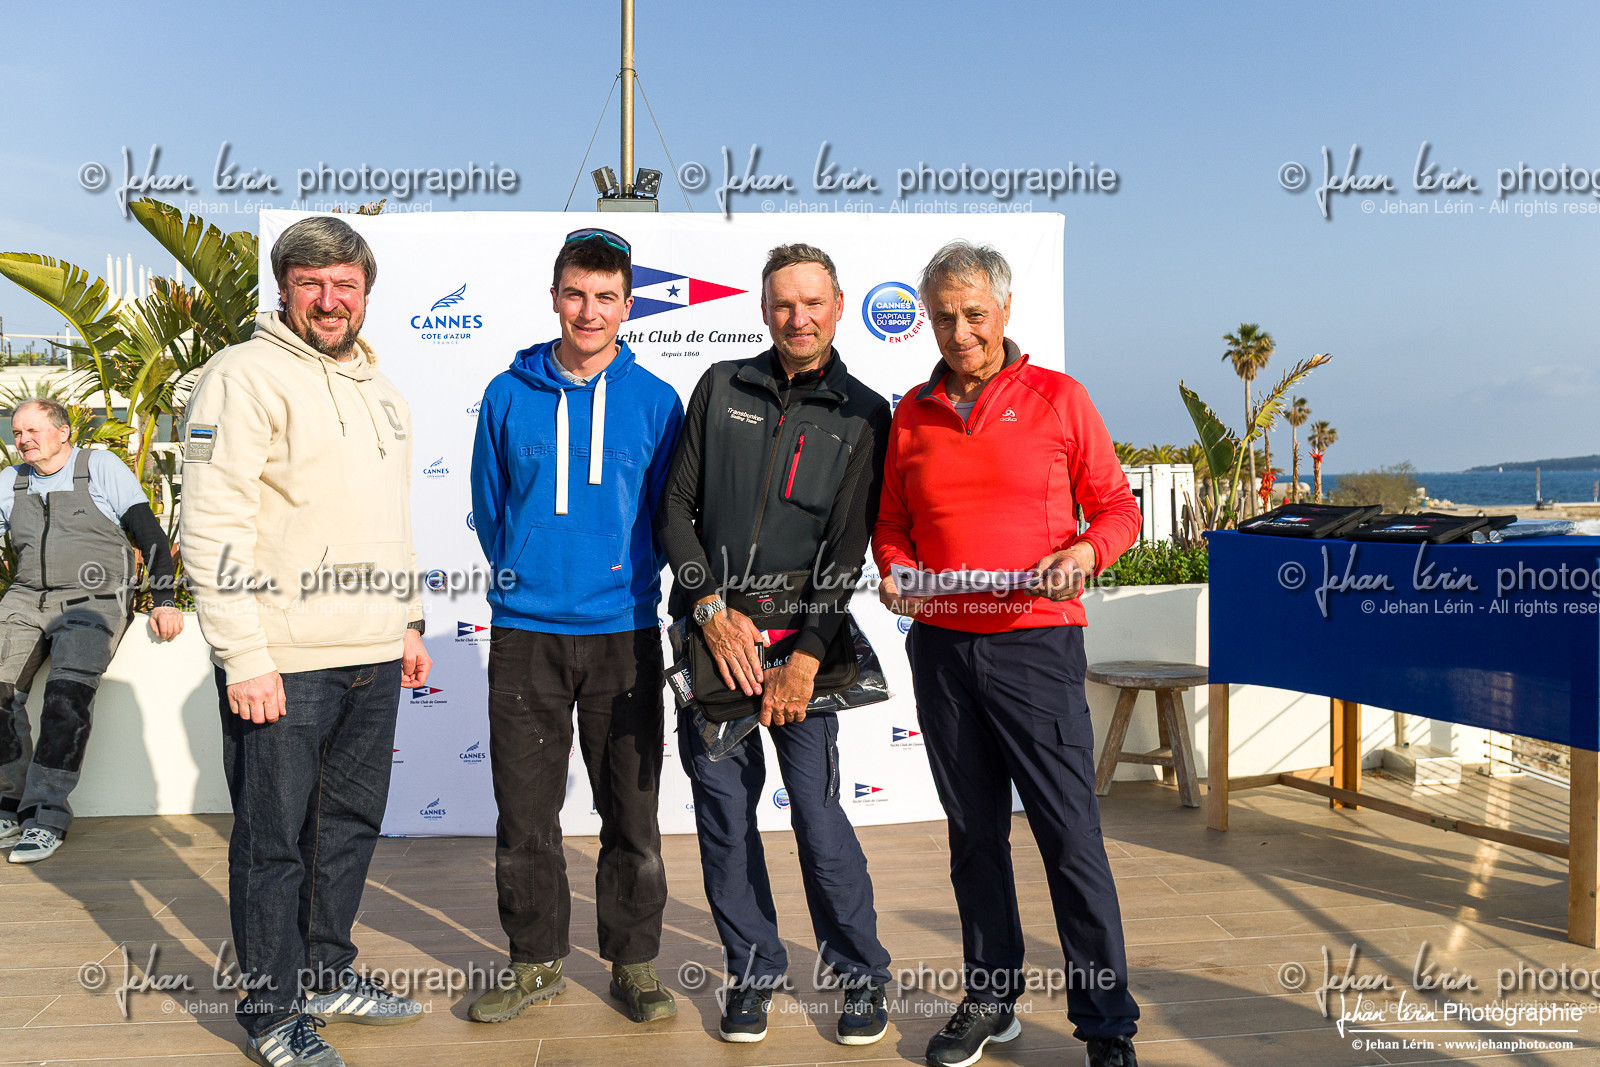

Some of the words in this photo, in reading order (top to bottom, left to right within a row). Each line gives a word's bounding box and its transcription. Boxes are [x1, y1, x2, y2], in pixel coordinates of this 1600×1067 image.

[410, 315, 483, 329] CANNES
[648, 330, 682, 342] Club
[686, 330, 704, 342] de
[709, 330, 763, 342] Cannes
[904, 320, 924, 340] PLEIN
